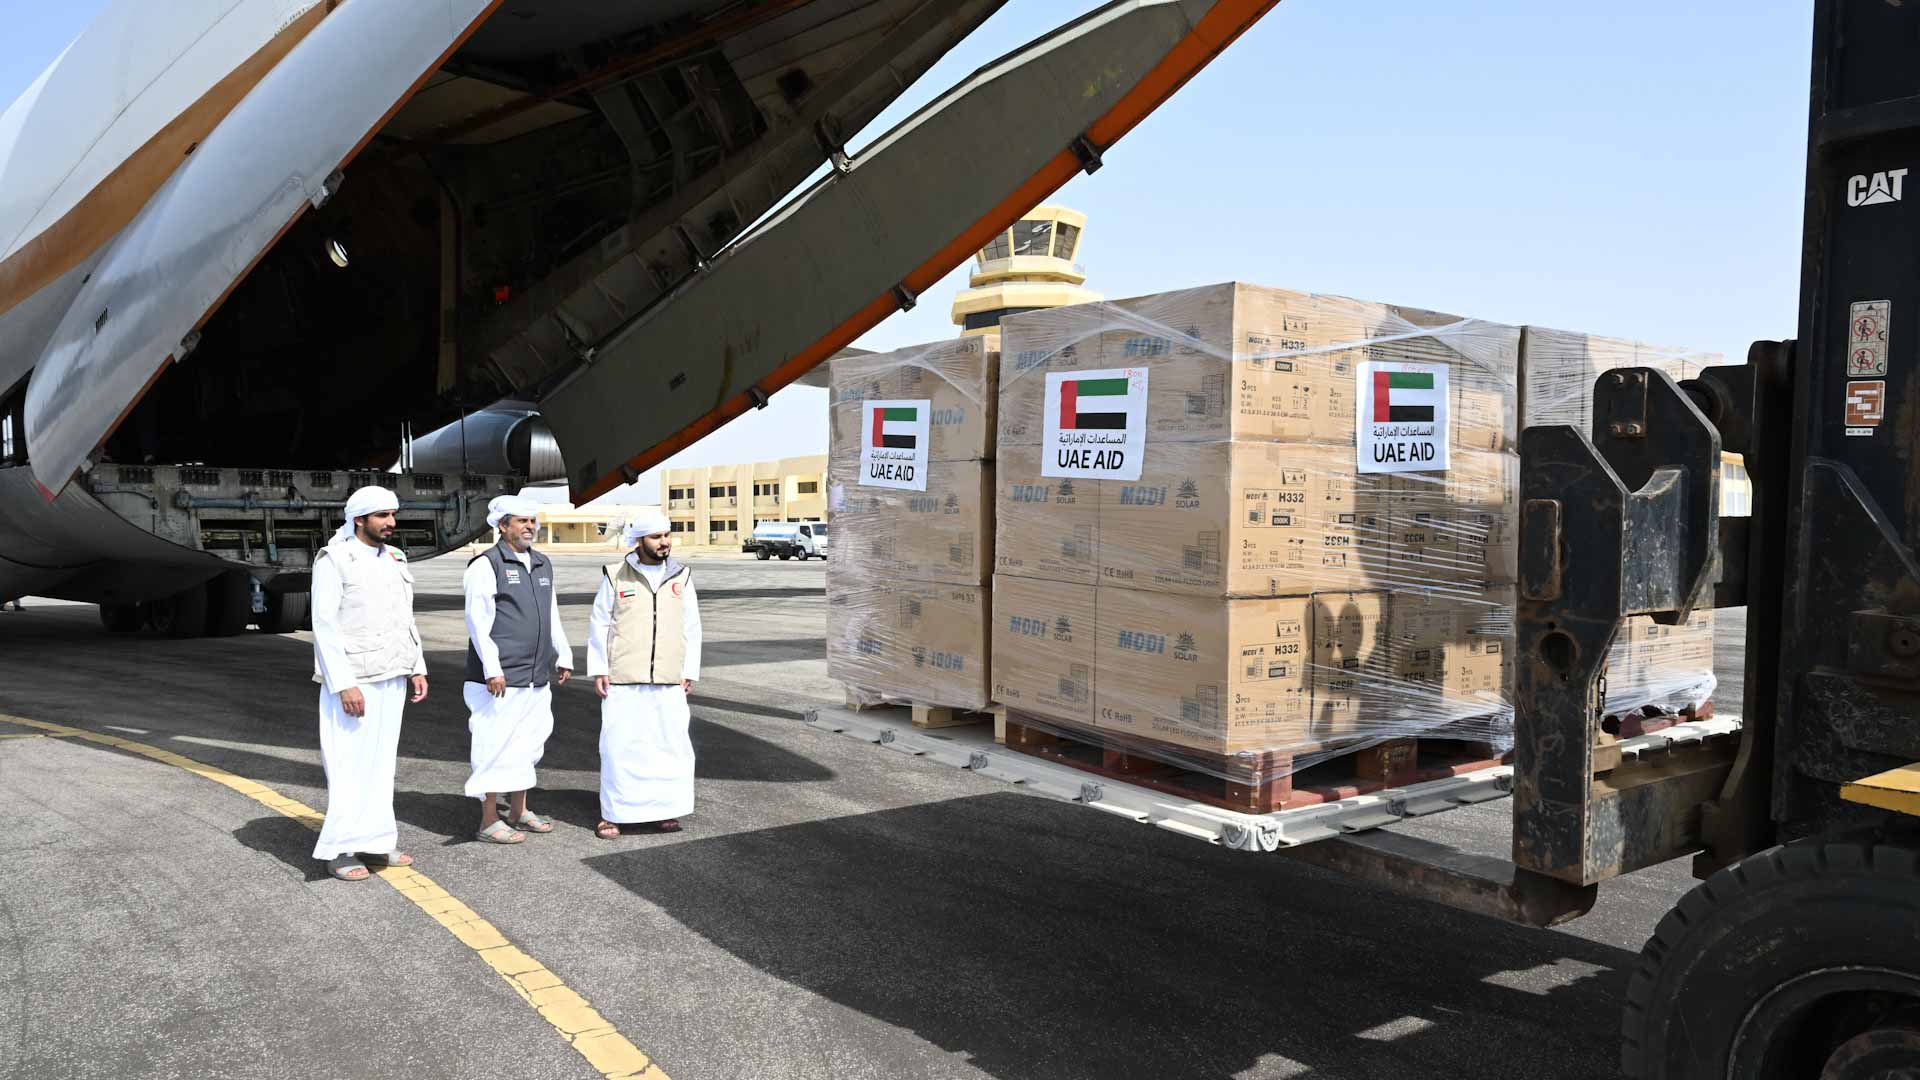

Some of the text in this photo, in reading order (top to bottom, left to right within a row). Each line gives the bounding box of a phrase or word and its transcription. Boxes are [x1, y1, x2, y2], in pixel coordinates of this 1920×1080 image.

[1847, 168, 1908, 207] CAT
[1059, 433, 1126, 446] المساعدات الإماراتية
[1373, 426, 1434, 440] المساعدات الإماراتية
[889, 452, 916, 461] المساعدات
[1374, 442, 1435, 463] UAE AID
[1058, 449, 1125, 470] UAE AID
[870, 463, 914, 482] UAE AID
[1011, 485, 1049, 504] MODI
[1056, 497, 1076, 505] SOLAR
[1120, 486, 1168, 506] MODI
[1279, 492, 1305, 503] H332
[1175, 499, 1200, 509] SOLAR
[1010, 616, 1047, 637] MODI
[1053, 633, 1073, 643] SOLAR
[1119, 630, 1167, 654] MODI
[1274, 644, 1299, 655] H332
[1173, 651, 1198, 662] SOLAR
[1114, 712, 1133, 724] RoHS
